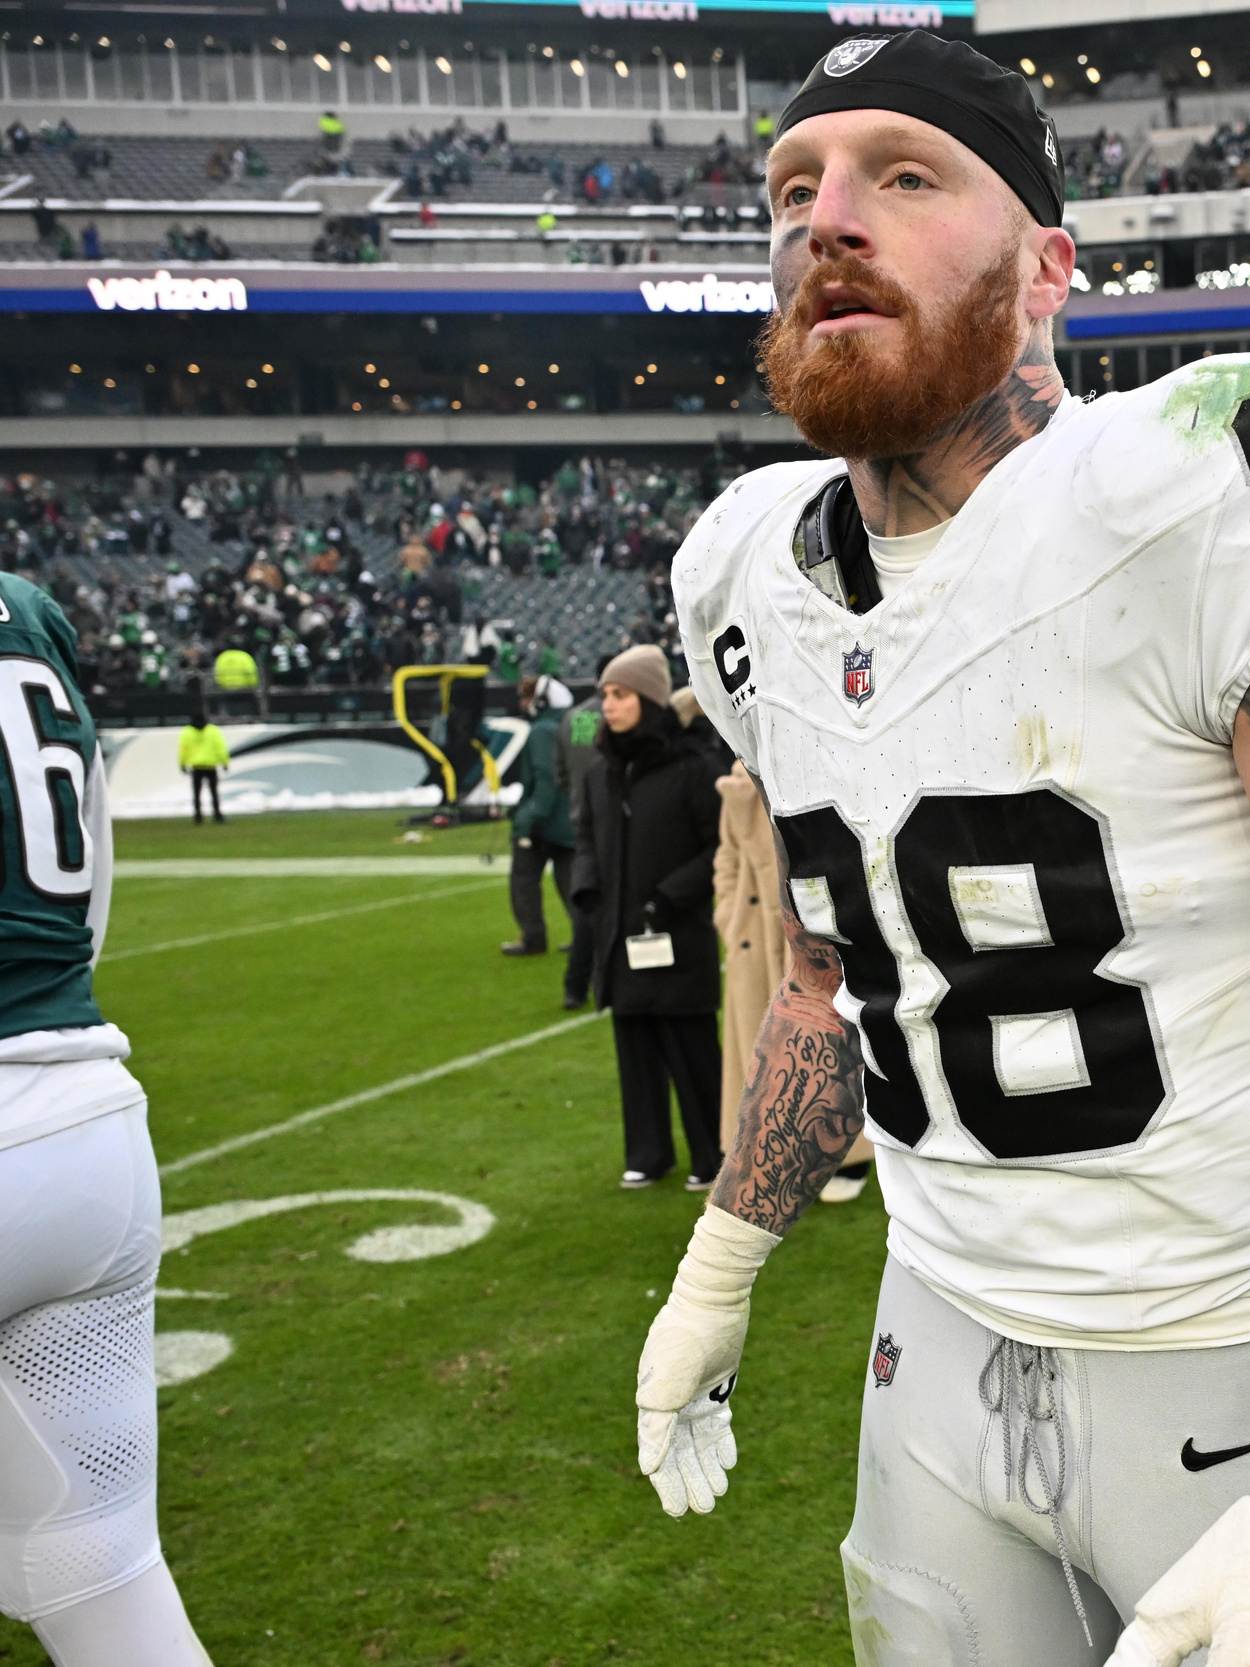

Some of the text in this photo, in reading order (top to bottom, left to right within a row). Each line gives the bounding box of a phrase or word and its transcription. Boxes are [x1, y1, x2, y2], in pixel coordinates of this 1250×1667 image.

[827, 3, 942, 28] verizon
[87, 269, 248, 311] verizon
[713, 625, 751, 695] C
[846, 671, 870, 696] NFL
[772, 778, 1177, 1166] 98
[875, 1352, 890, 1379] NFL
